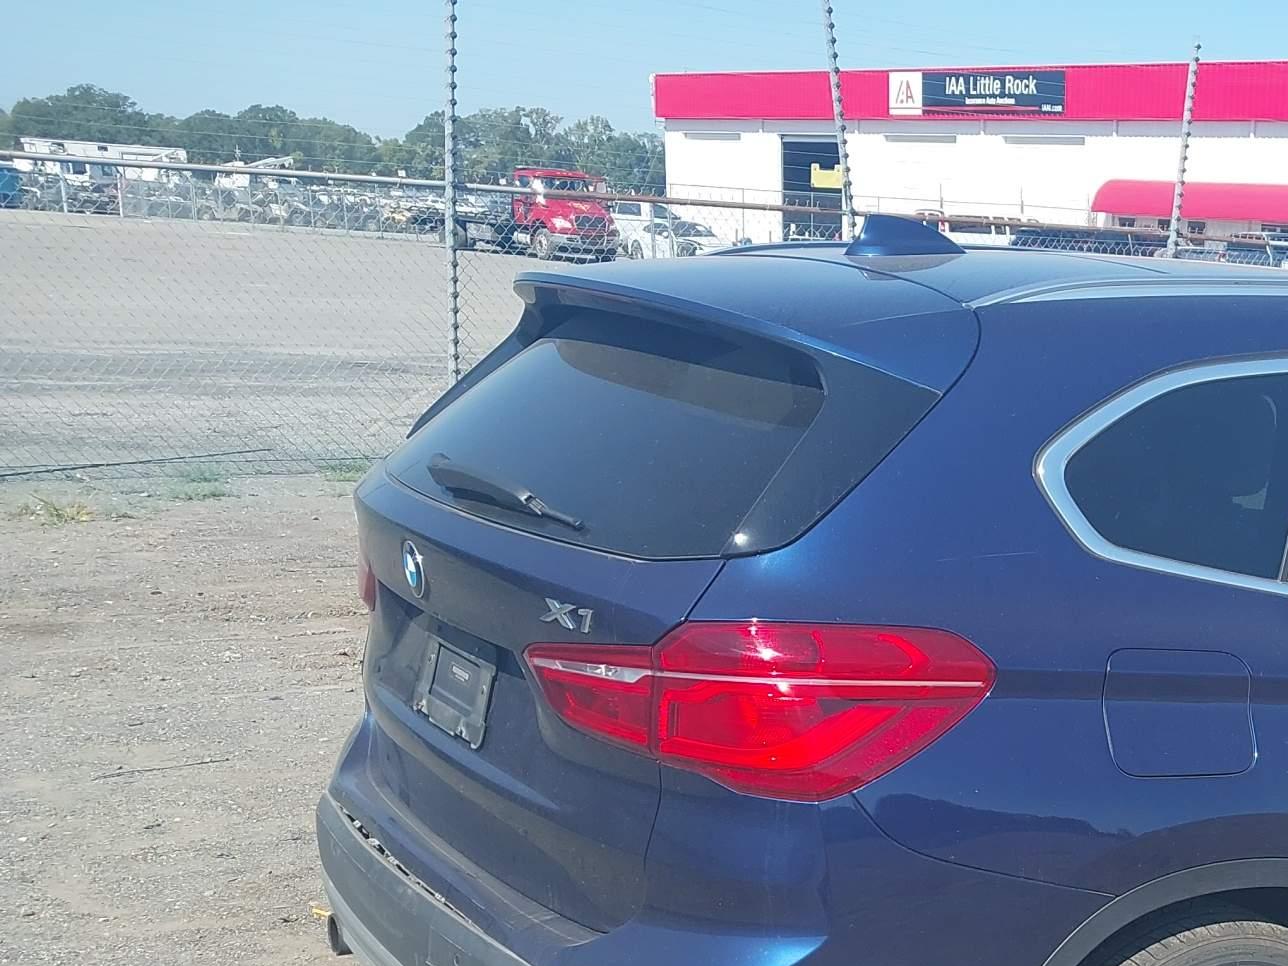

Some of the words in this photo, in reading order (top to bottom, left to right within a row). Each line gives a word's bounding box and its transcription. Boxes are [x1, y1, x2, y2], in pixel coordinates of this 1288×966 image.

[945, 76, 966, 95] IAA
[969, 75, 1001, 95] Little
[1005, 74, 1038, 95] Rock
[539, 597, 594, 634] X1
